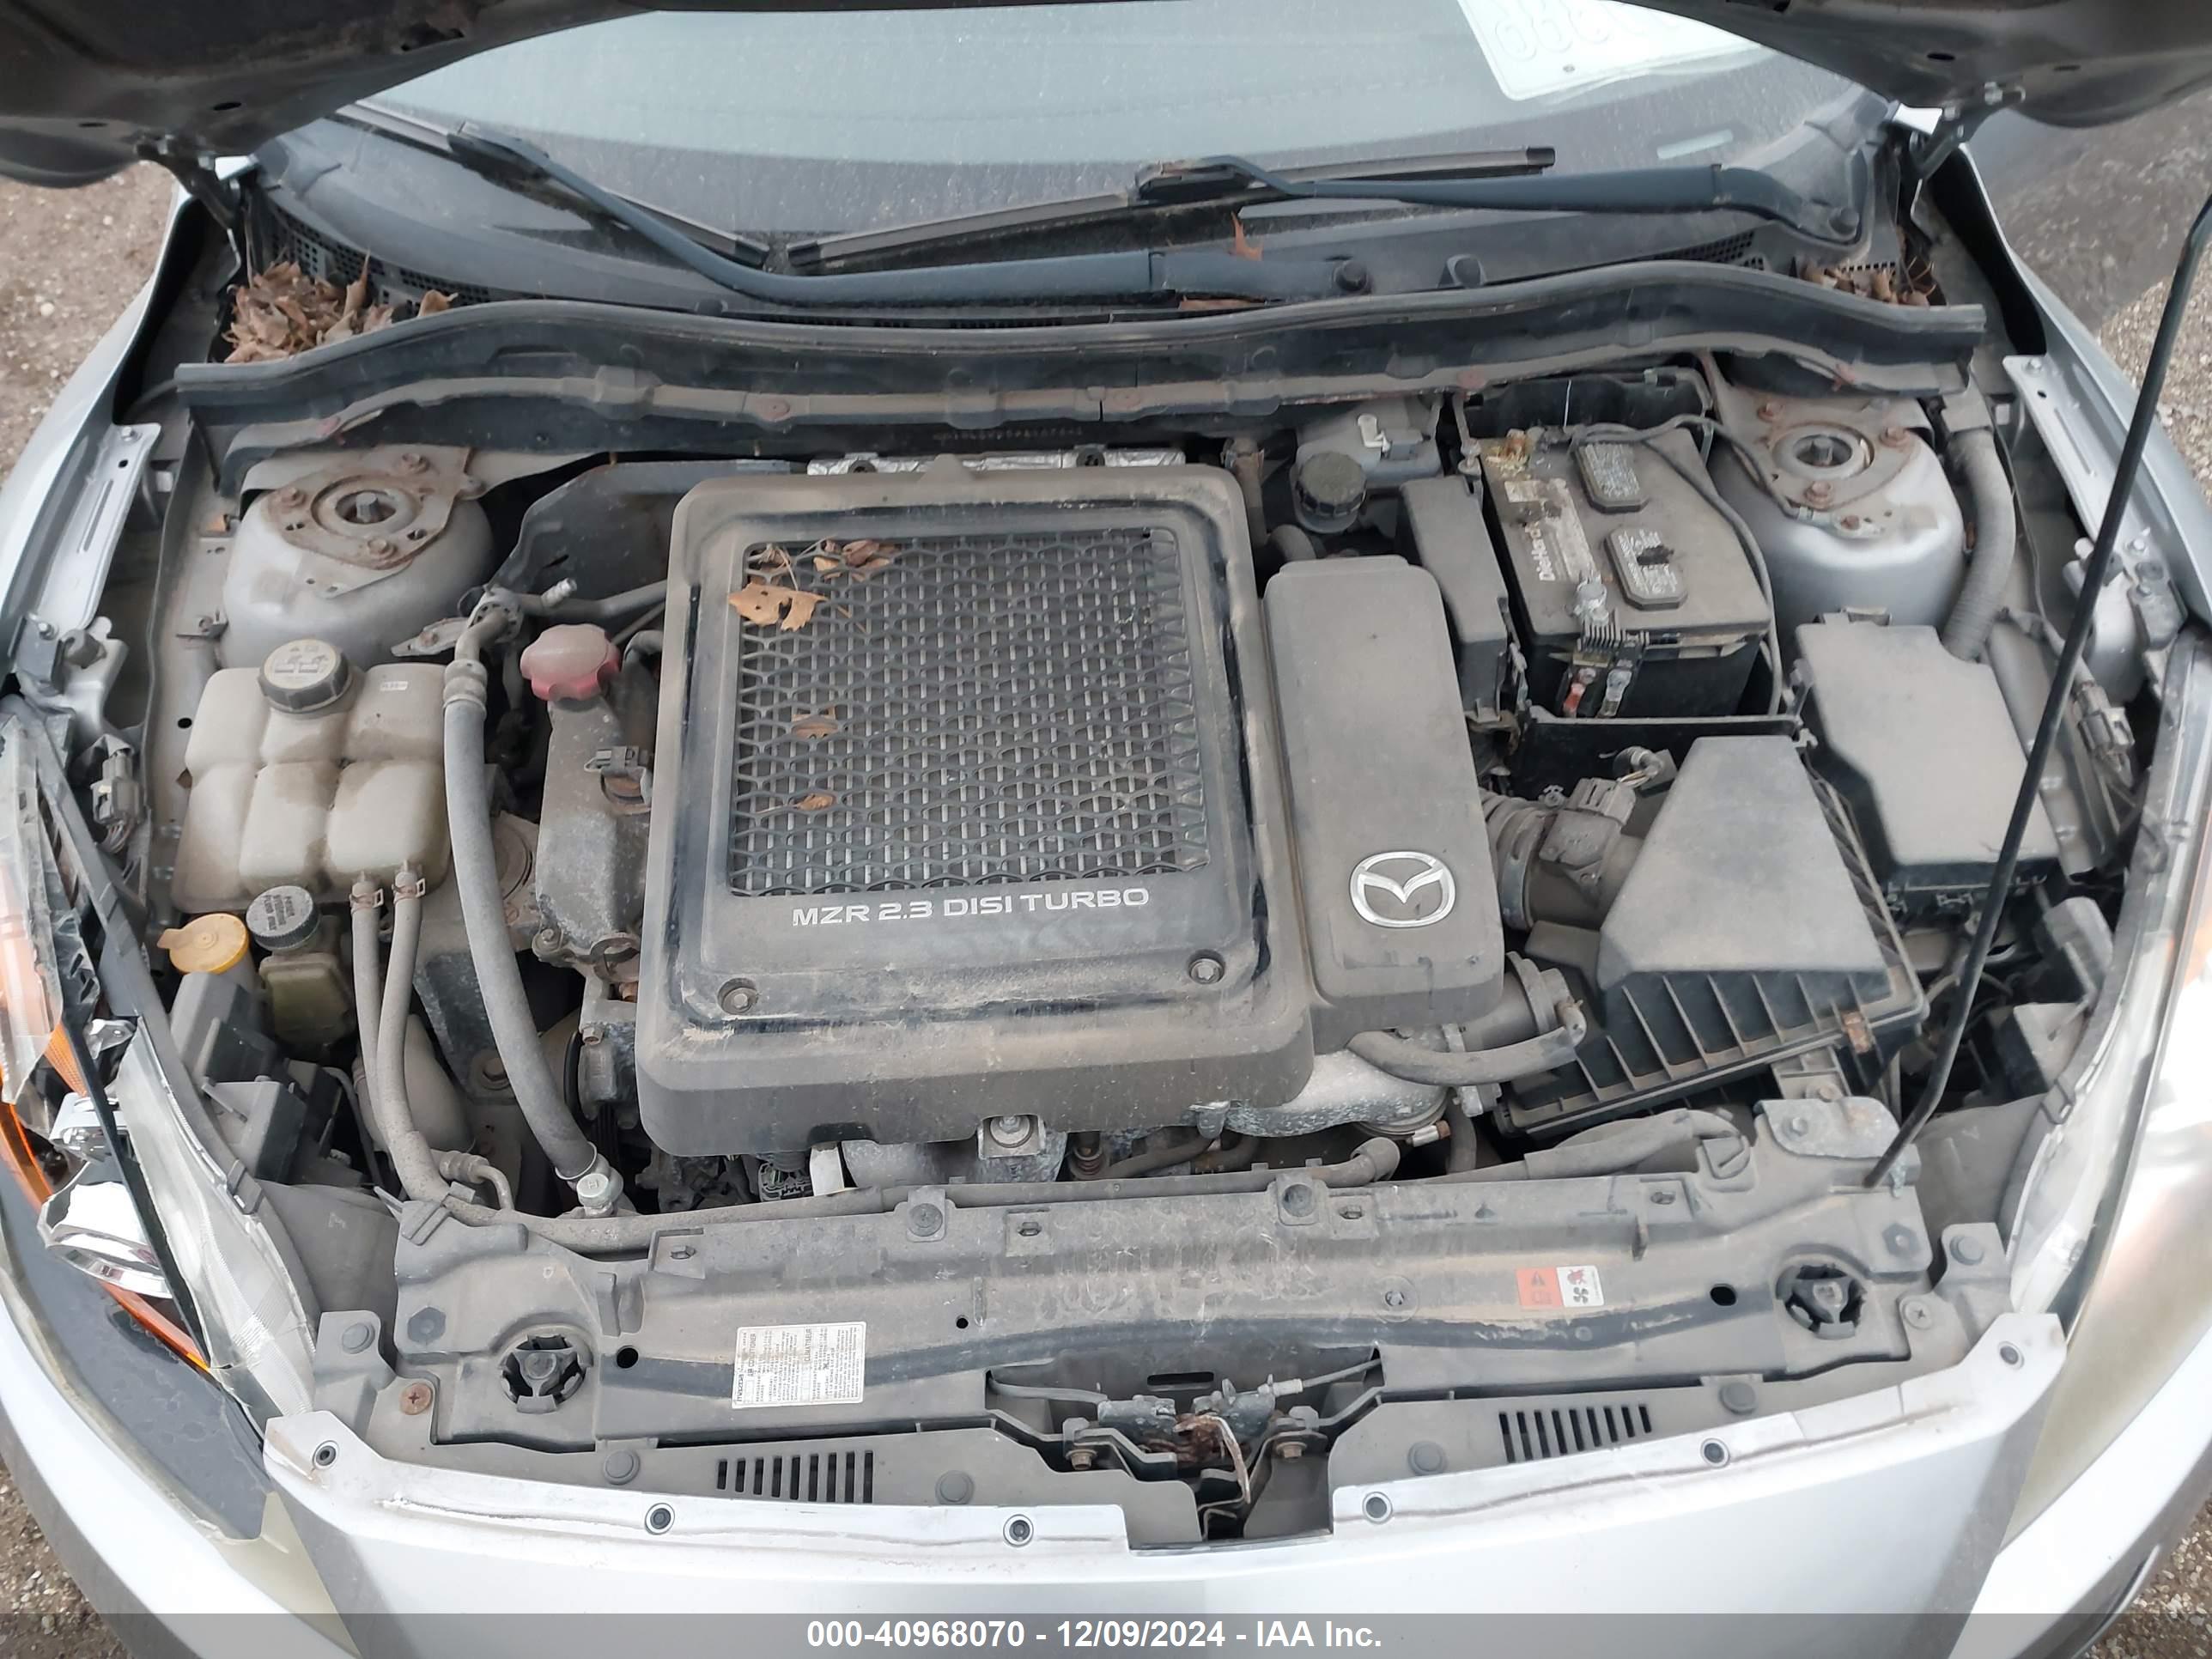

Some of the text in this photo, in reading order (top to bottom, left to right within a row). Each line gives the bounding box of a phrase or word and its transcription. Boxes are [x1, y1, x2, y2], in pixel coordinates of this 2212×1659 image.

[793, 888, 1149, 927] MZR 2.3 DISI TURBO
[748, 1333, 757, 1367] COITIONER
